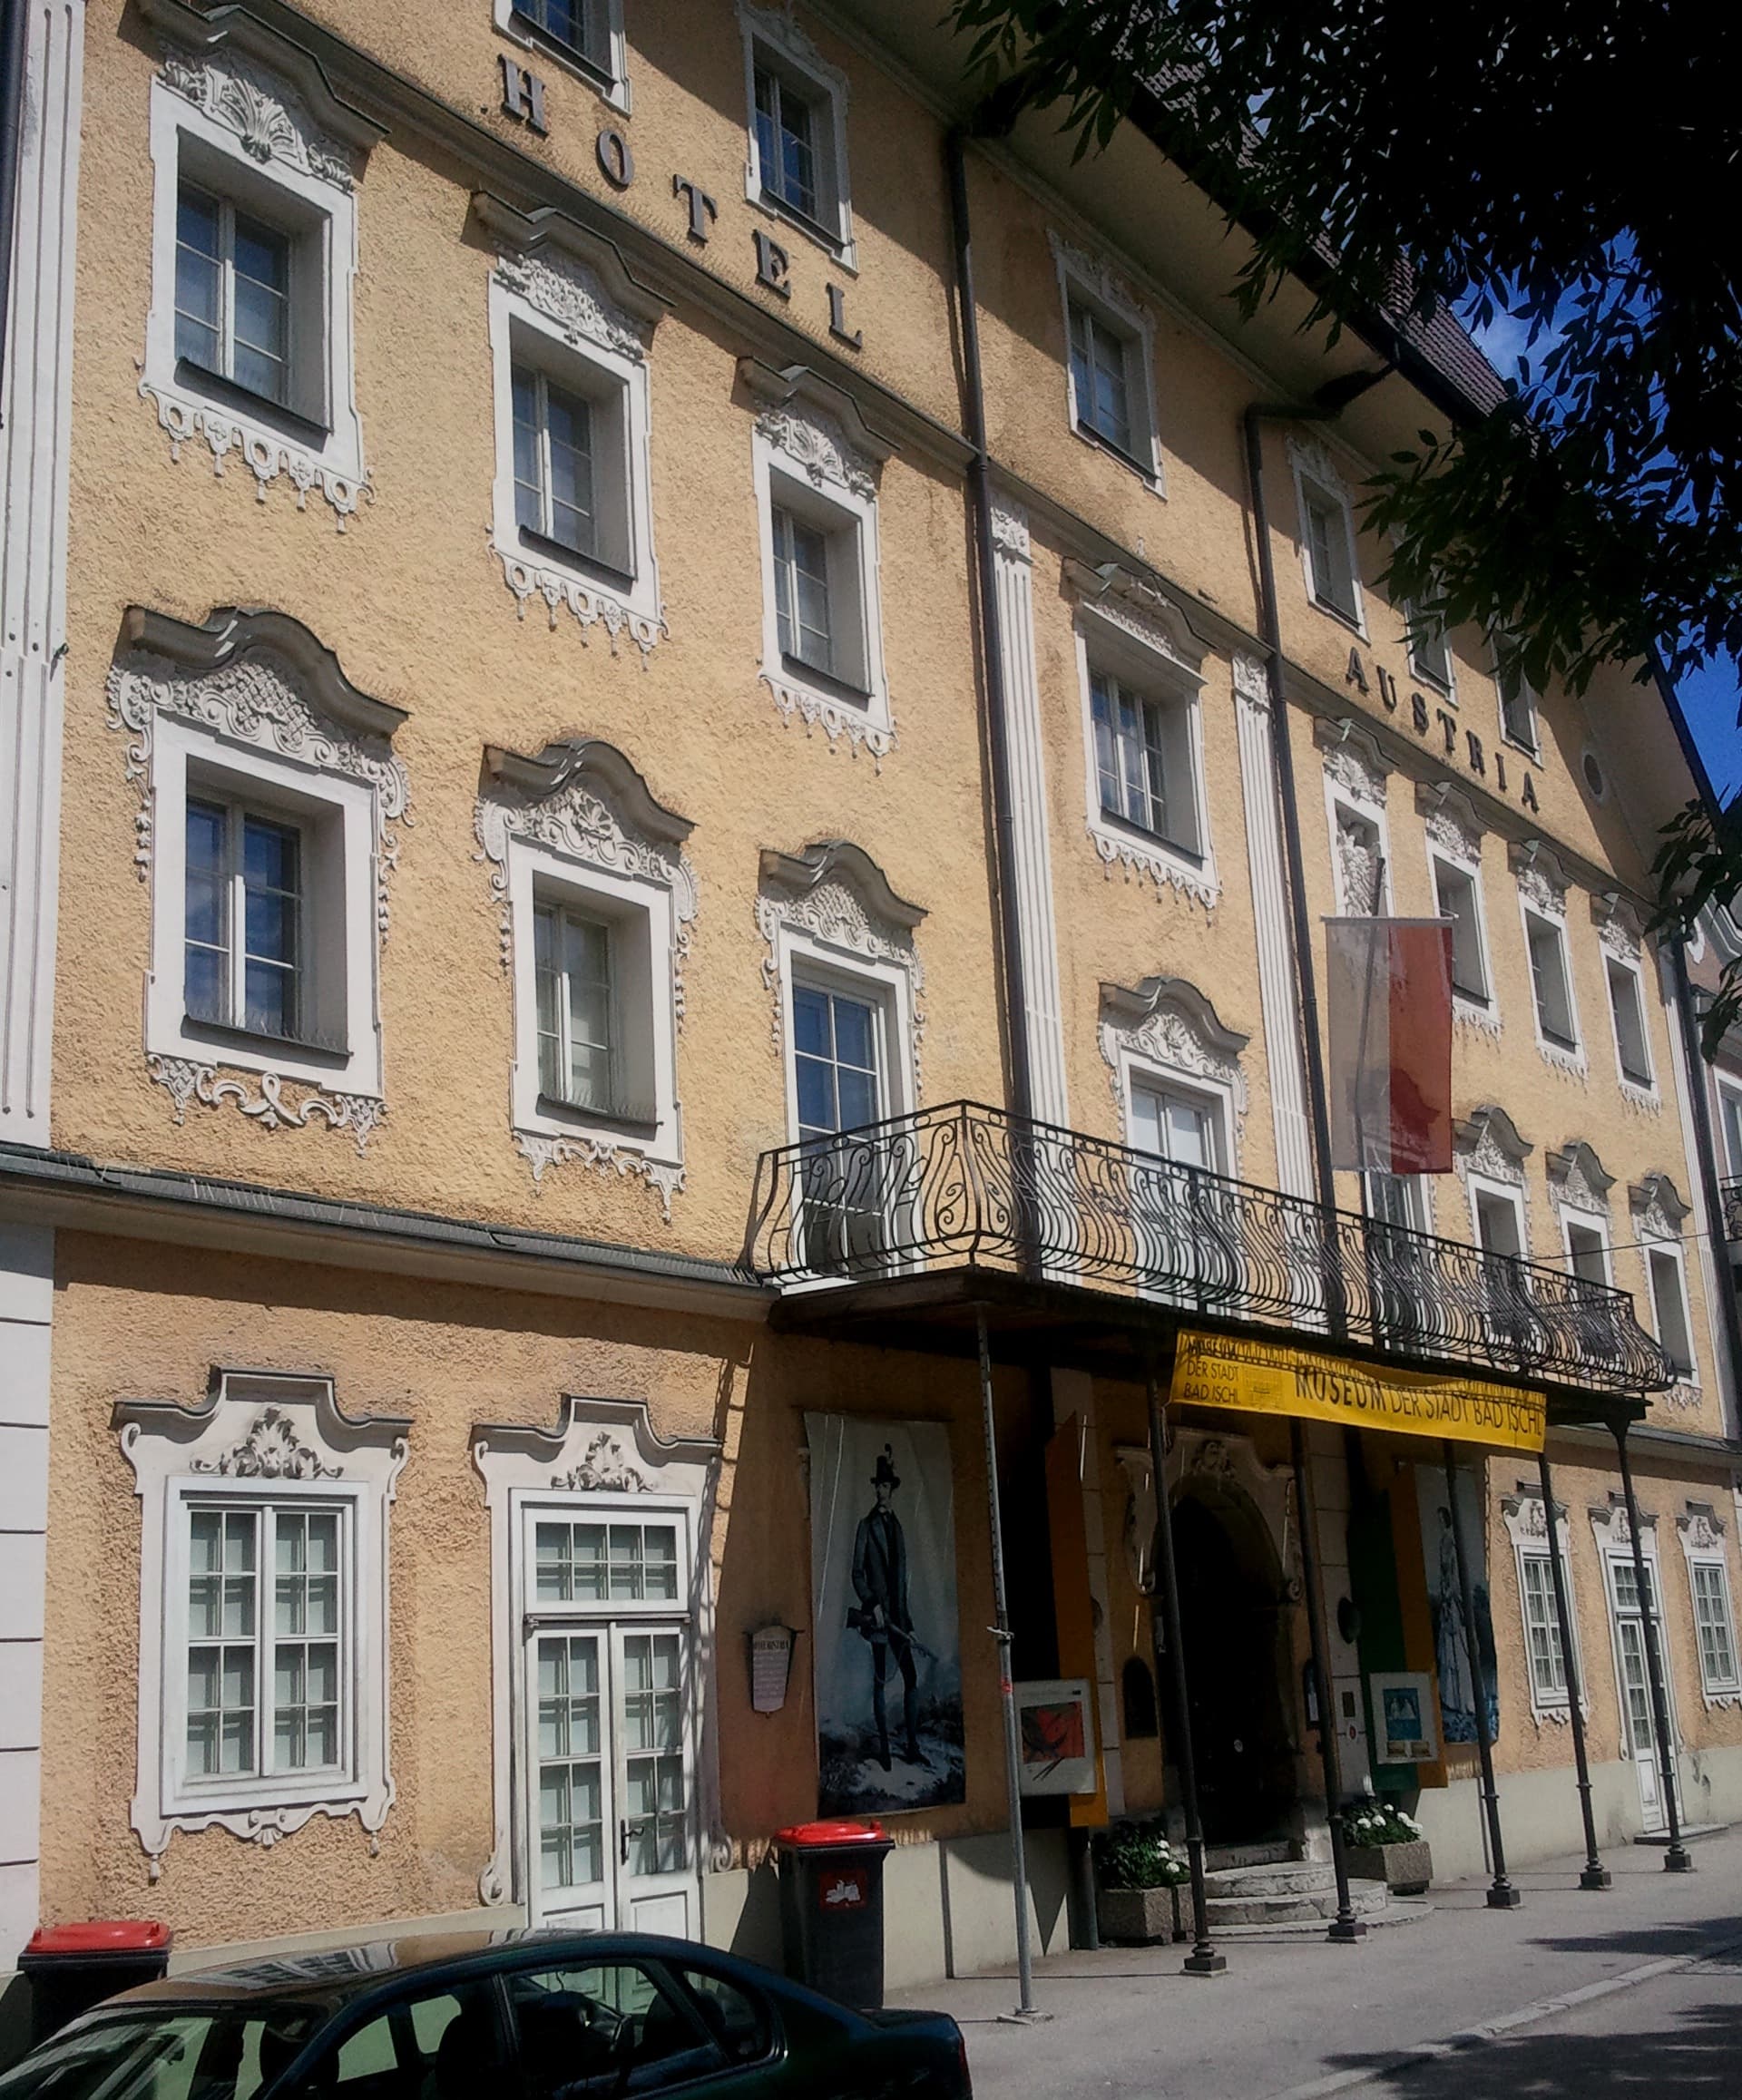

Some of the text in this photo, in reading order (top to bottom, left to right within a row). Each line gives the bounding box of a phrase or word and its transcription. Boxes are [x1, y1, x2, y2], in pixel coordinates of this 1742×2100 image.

[497, 54, 863, 351] HOTEL
[1346, 646, 1540, 814] AUSTRIA
[1183, 1382, 1209, 1400] BAD
[1212, 1385, 1241, 1404] ISCHL
[1187, 1360, 1238, 1382] DER STADT
[1295, 1366, 1386, 1411] MUSEUM
[1389, 1388, 1422, 1417] DER
[1424, 1392, 1468, 1422] STADT
[1473, 1397, 1503, 1428] BAD
[1507, 1402, 1541, 1436] ISCHL
